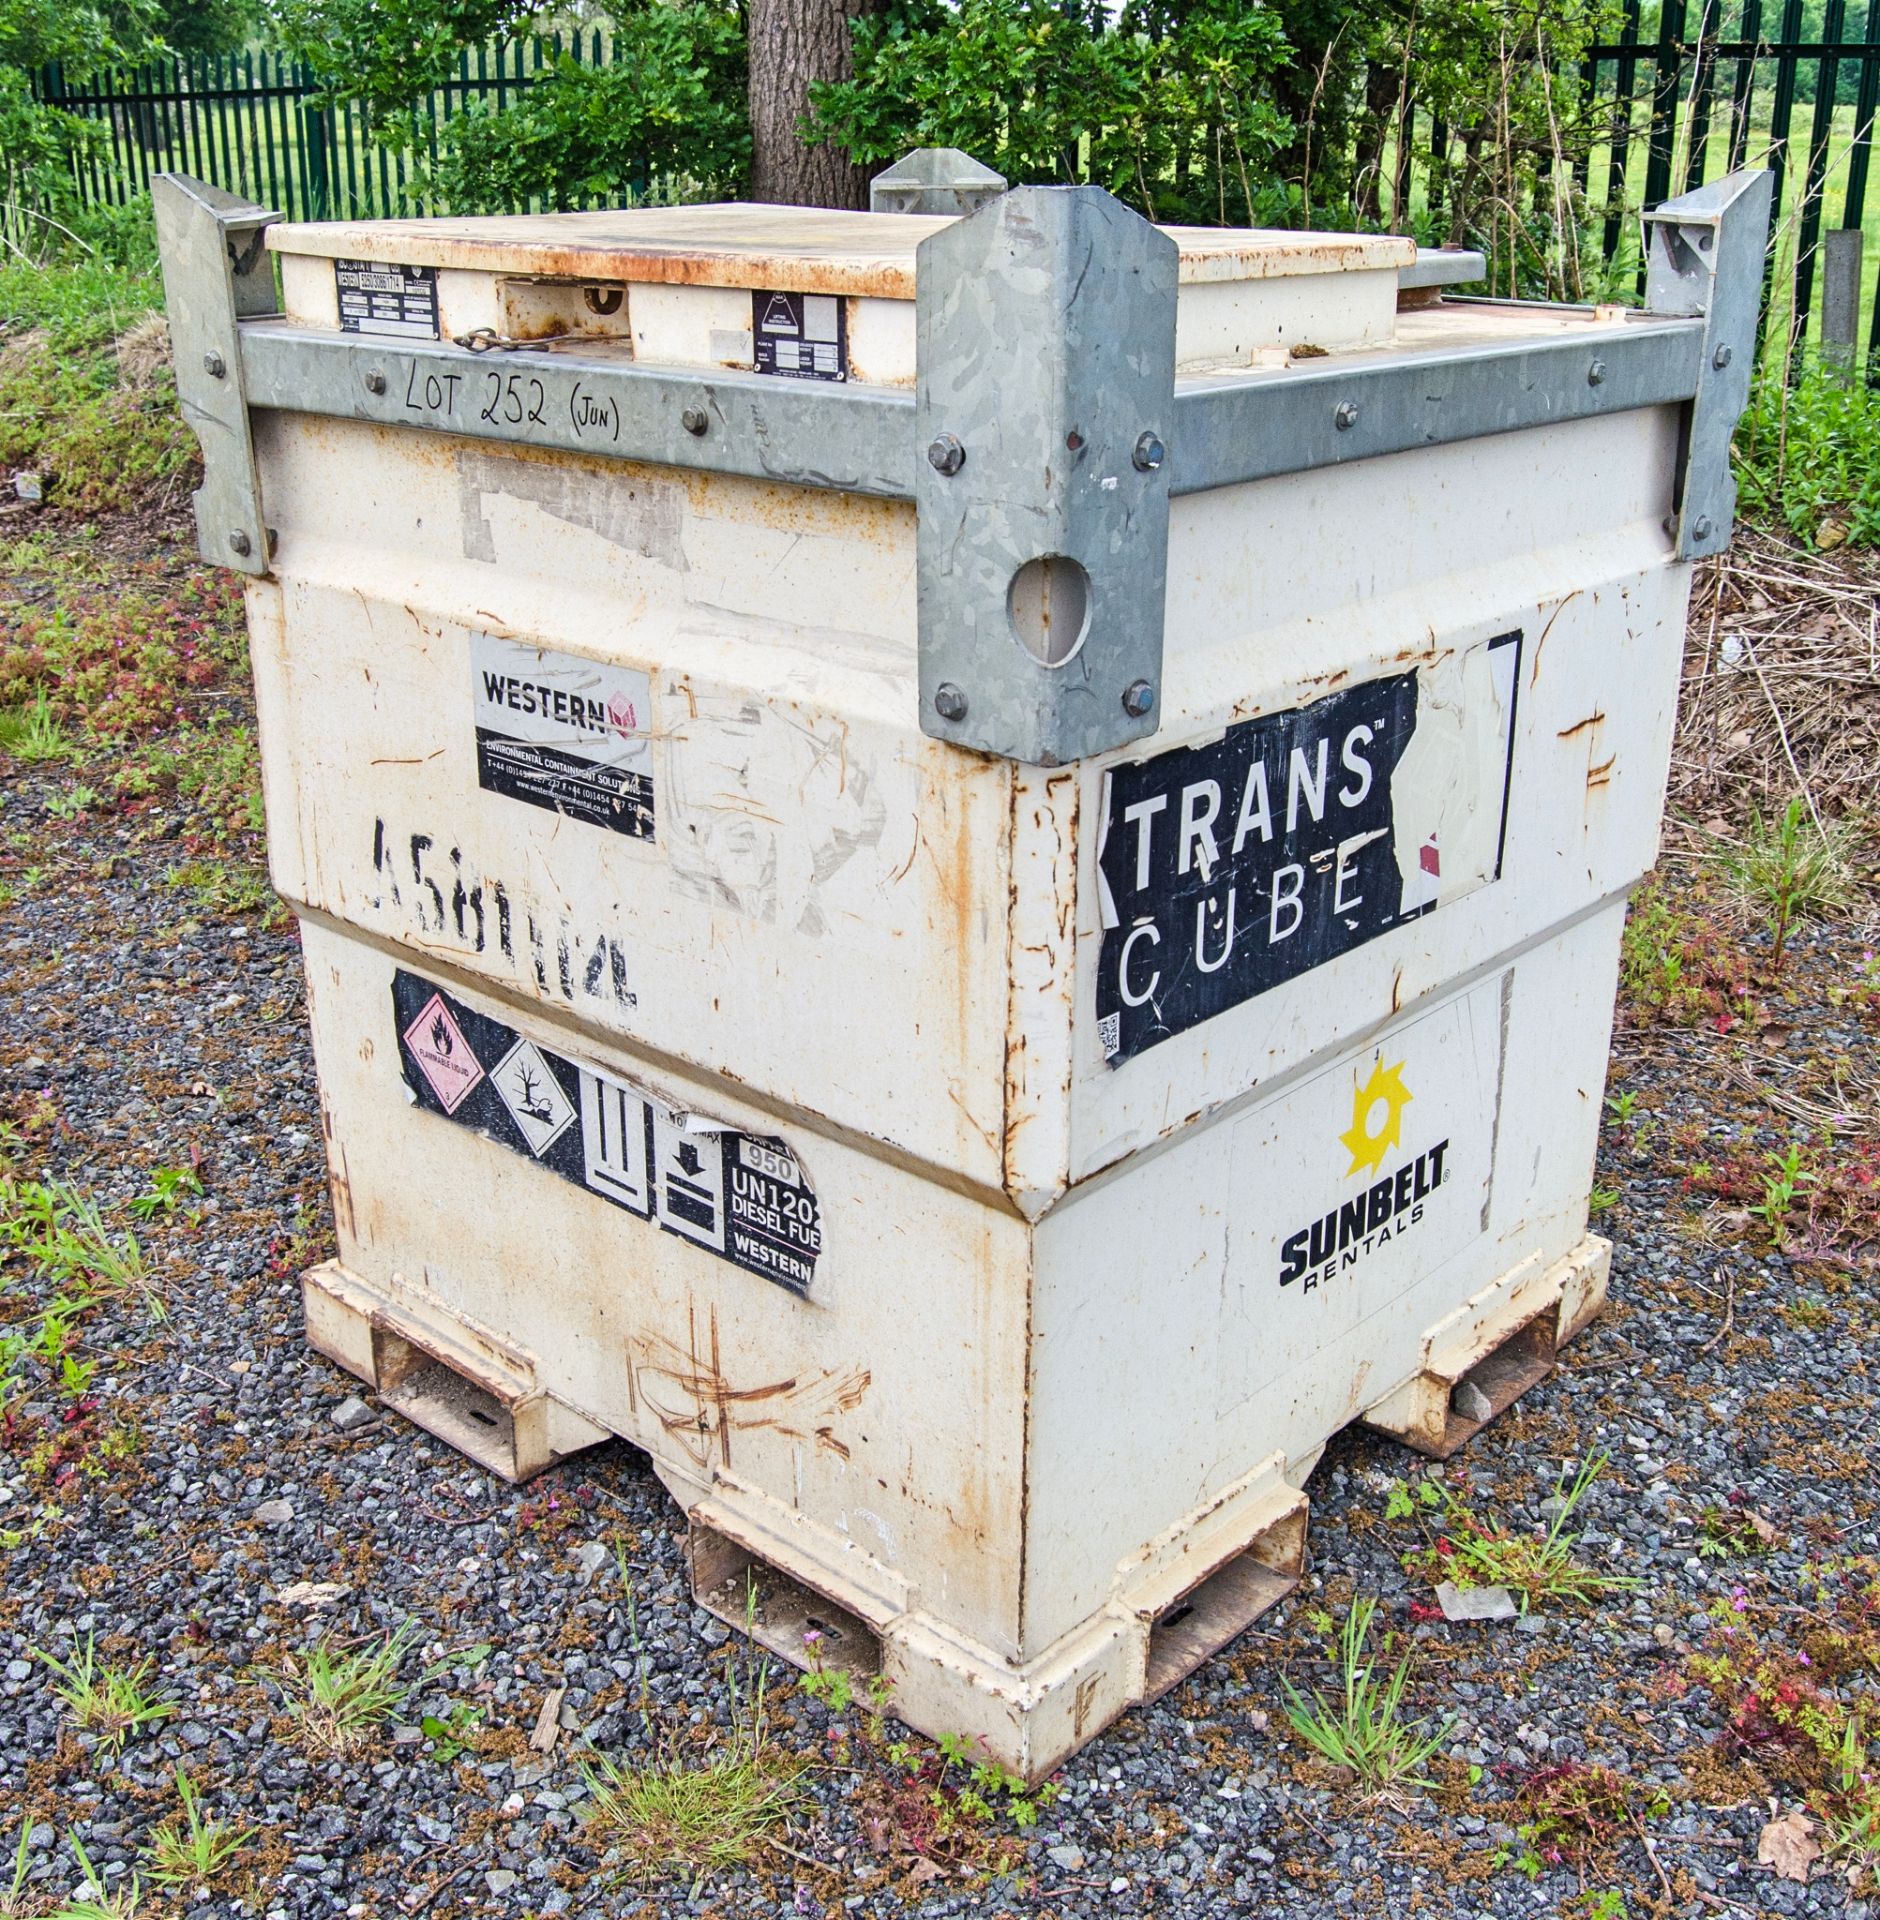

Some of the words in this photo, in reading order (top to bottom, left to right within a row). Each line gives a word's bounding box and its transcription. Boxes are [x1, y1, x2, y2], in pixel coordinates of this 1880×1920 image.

[406, 358, 461, 415] LOT
[481, 372, 547, 426] 252
[482, 670, 605, 734] WESTERN
[1124, 724, 1375, 892] TRANS
[1119, 830, 1372, 1008] CUBE
[419, 1048, 451, 1069] FLAMMABLE
[451, 1062, 469, 1077] LIQUID
[445, 1091, 450, 1101] 3
[748, 1145, 792, 1180] 950
[732, 1194, 786, 1235] DIESEL
[1280, 1138, 1449, 1287] SUNBELT
[734, 1232, 812, 1283] WESTERN
[1303, 1203, 1424, 1294] RENTALS
